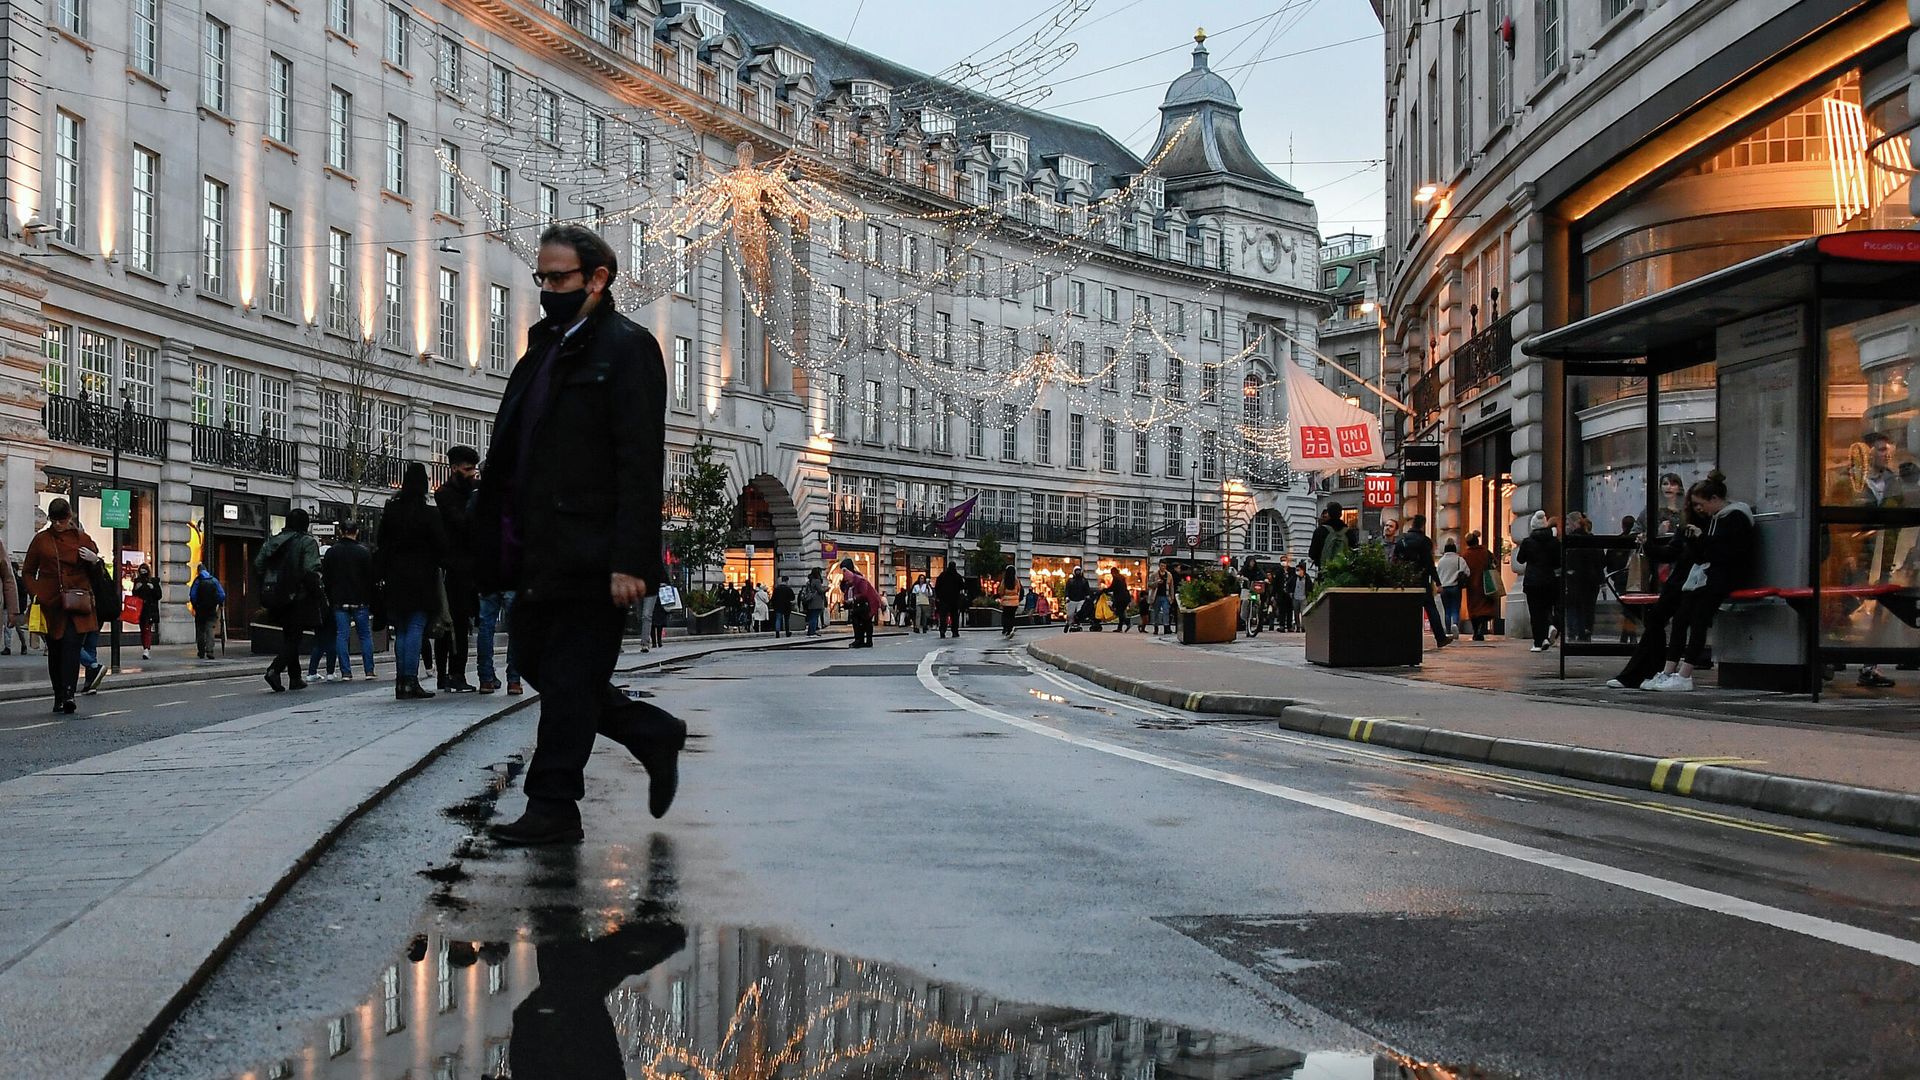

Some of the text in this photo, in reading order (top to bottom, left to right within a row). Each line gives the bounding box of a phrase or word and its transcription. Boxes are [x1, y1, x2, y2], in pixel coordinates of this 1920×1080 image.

[1863, 240, 1903, 252] Piccadilly
[1340, 427, 1364, 441] UNI
[1343, 440, 1368, 456] QLO
[1368, 480, 1390, 491] UNI
[1368, 492, 1392, 505] QLO
[1151, 537, 1176, 547] Super
[1151, 545, 1165, 555] Dry
